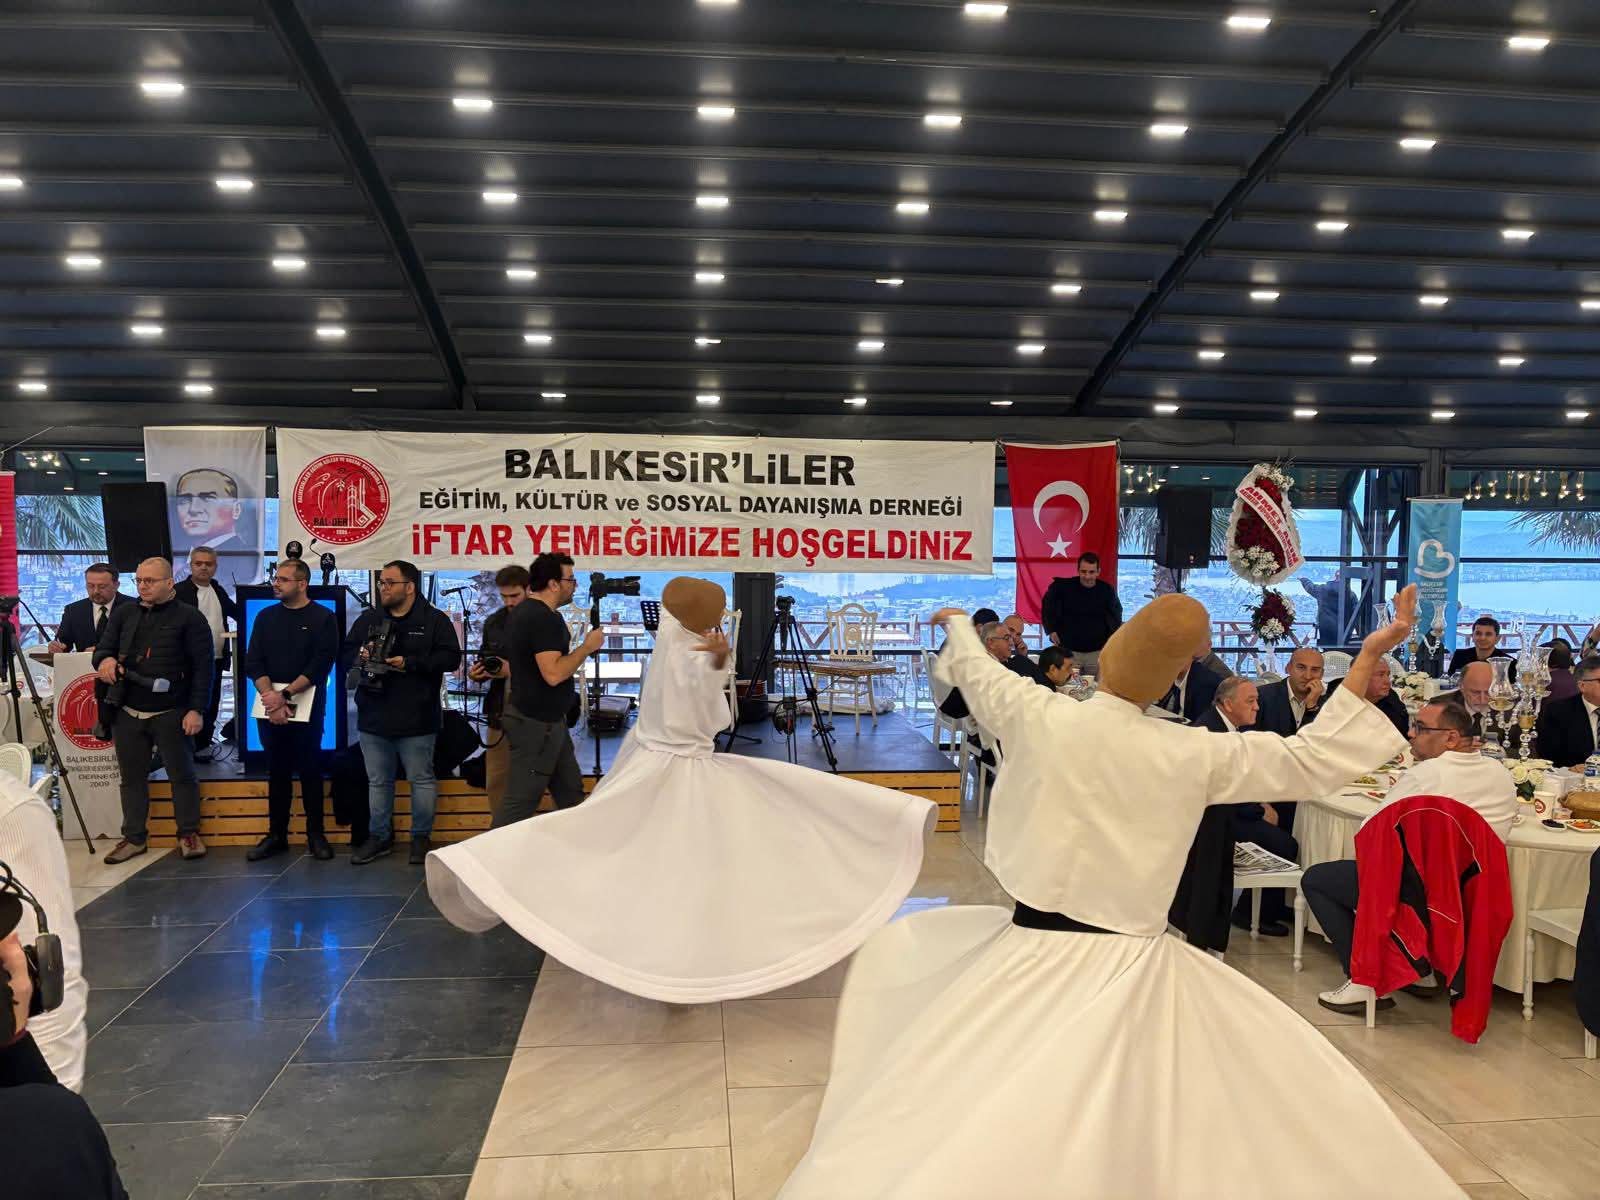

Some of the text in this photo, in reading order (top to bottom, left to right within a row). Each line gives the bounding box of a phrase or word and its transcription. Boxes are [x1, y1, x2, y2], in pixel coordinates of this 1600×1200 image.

[419, 488, 962, 519] EĞİTİM, KÜLTÜR ve SOSYAL DAYANIŞMA DERNEĞİ
